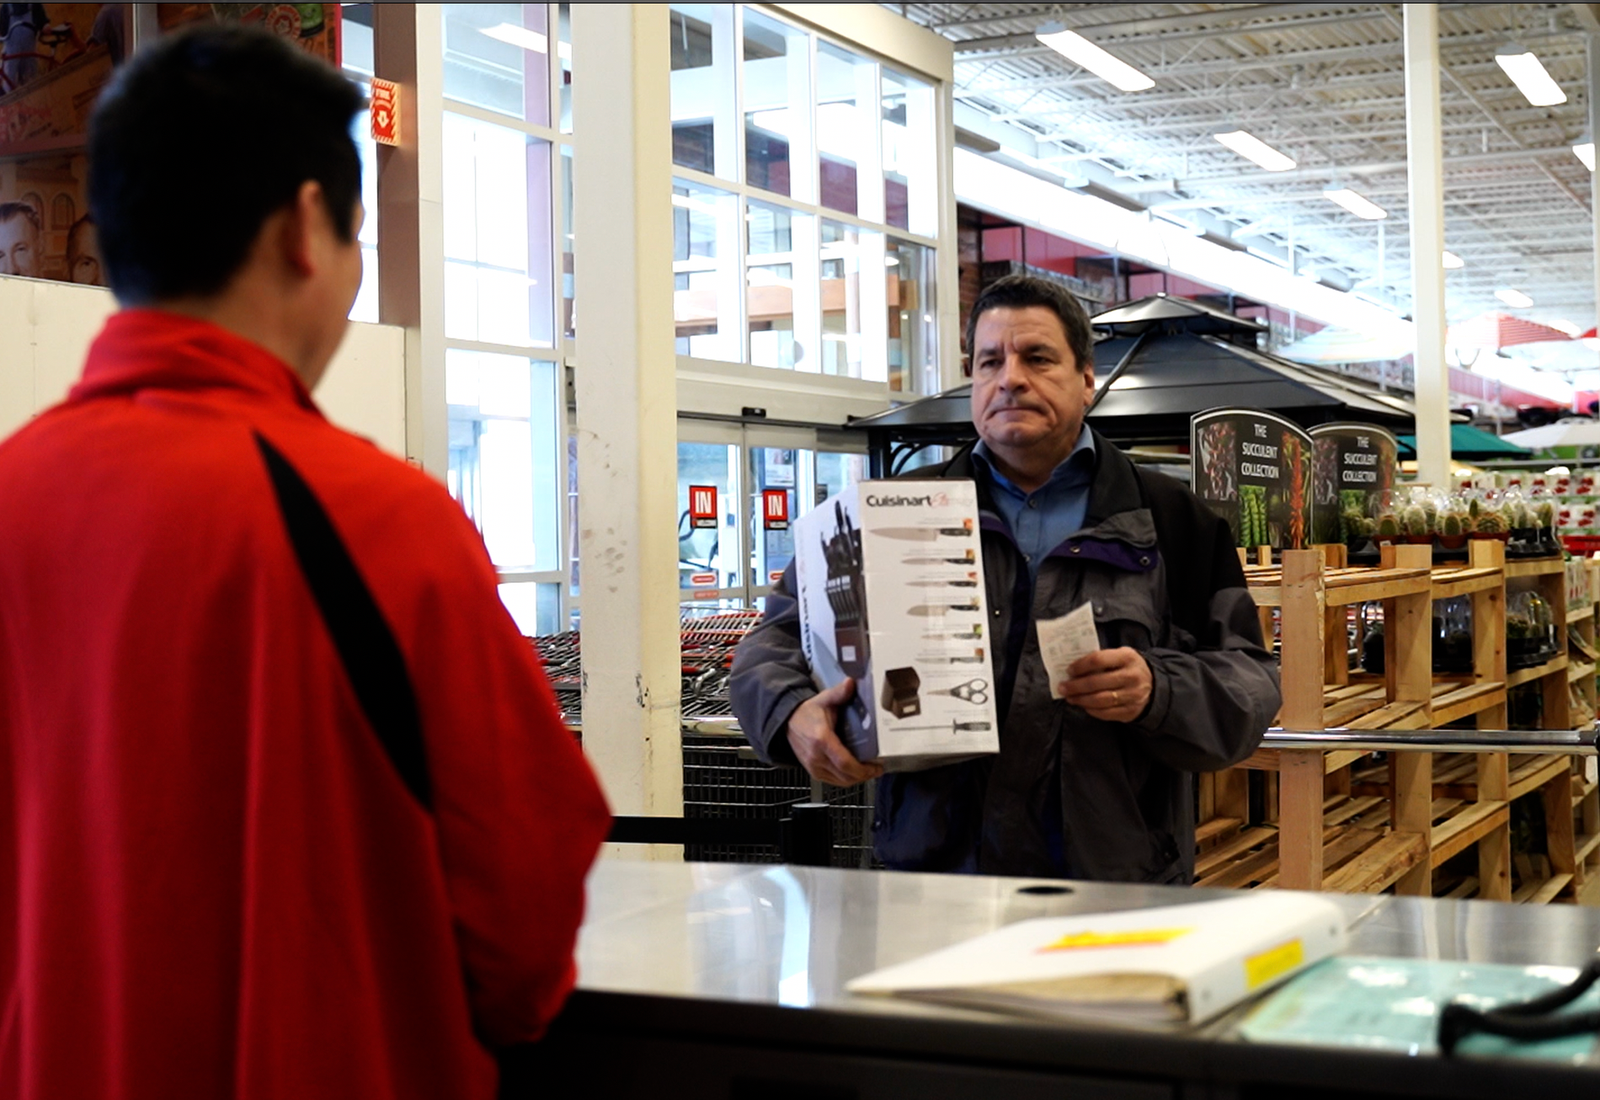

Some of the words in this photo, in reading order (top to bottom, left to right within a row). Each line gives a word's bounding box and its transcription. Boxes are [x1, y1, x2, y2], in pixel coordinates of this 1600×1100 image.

[1254, 424, 1267, 438] THE
[1242, 442, 1278, 459] SUCCULENT
[1357, 436, 1370, 448] THE
[1241, 462, 1279, 479] COLLECTION
[695, 491, 712, 514] IN
[768, 495, 783, 516] IN
[866, 495, 932, 507] Cuisinart
